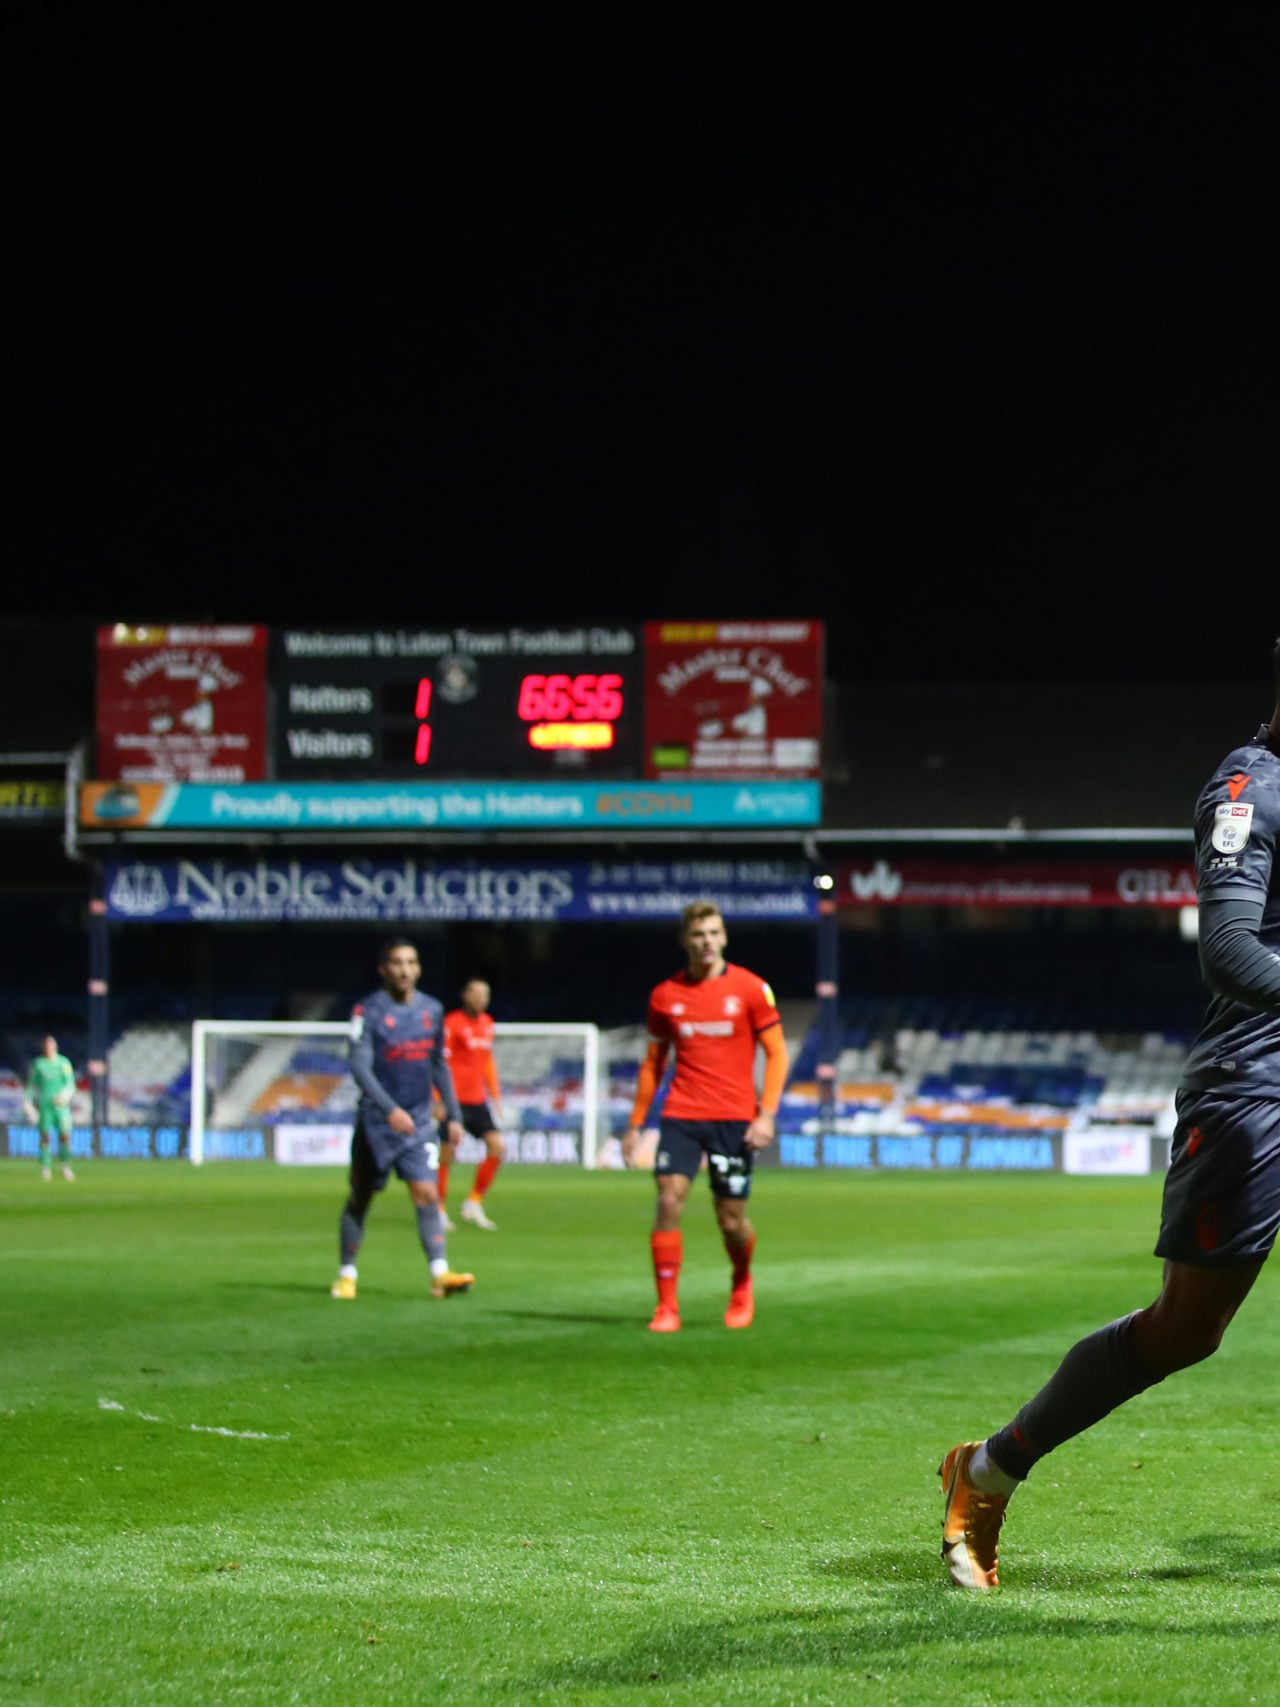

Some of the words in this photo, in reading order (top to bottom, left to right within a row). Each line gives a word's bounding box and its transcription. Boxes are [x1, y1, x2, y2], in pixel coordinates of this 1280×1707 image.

[286, 631, 371, 656] Welcome
[397, 631, 452, 656] Luton
[454, 629, 507, 655] Town
[509, 628, 587, 655] Football
[589, 628, 635, 655] Club
[289, 685, 373, 712] Hatters
[414, 677, 432, 720] 1
[288, 729, 373, 759] Visitors
[414, 723, 432, 765] 1
[210, 792, 302, 823] Proudly
[308, 793, 437, 823] supporting
[442, 792, 481, 817] the
[486, 792, 583, 818] Hatters
[1218, 807, 1230, 816] sky
[1233, 807, 1247, 816] bet
[1222, 840, 1234, 848] EFL
[174, 860, 333, 906] Noble
[340, 859, 573, 907] Solicitors
